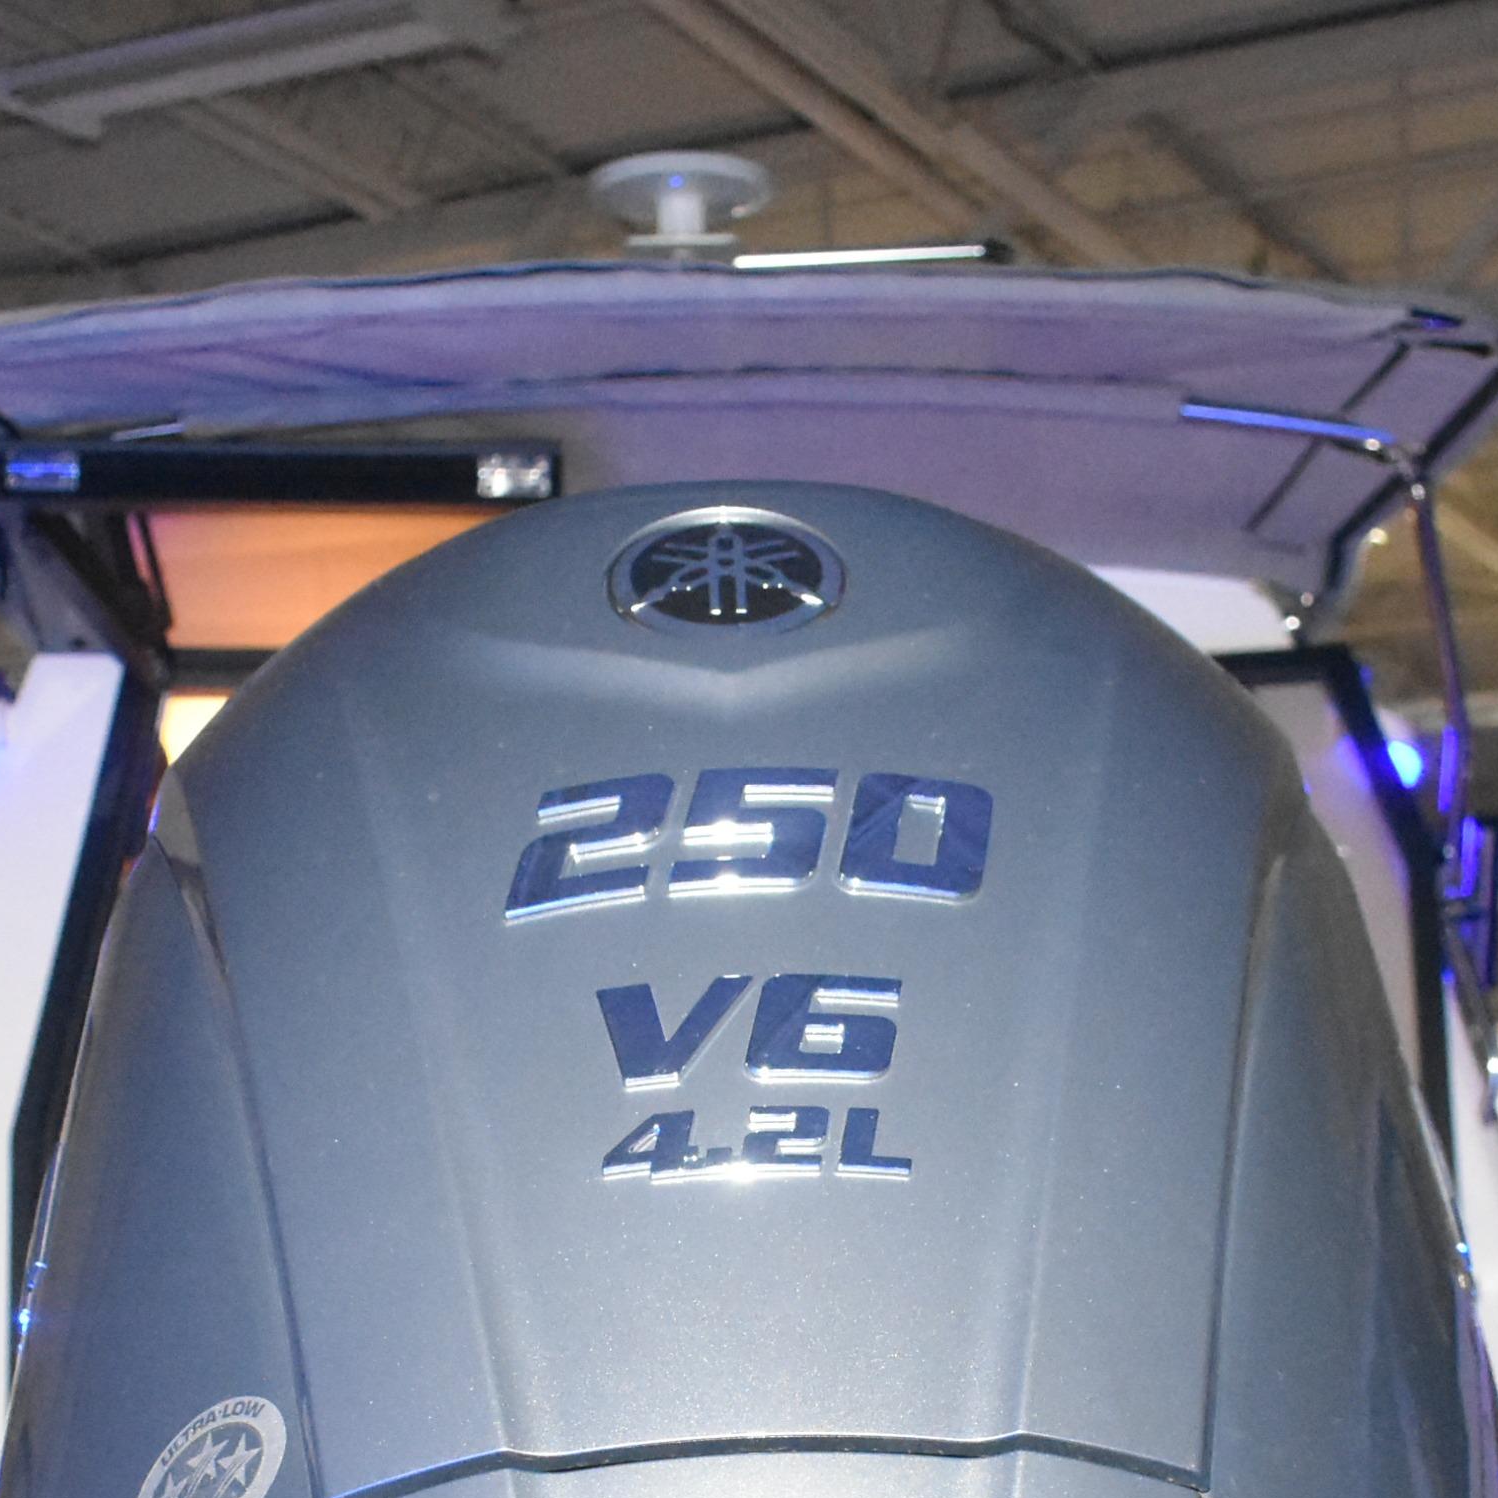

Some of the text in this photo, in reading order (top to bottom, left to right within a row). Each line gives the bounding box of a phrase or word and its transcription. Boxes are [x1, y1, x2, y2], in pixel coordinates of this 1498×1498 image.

[504, 766, 993, 924] 250
[596, 972, 903, 1092] V6
[601, 1105, 913, 1184] 4.2L
